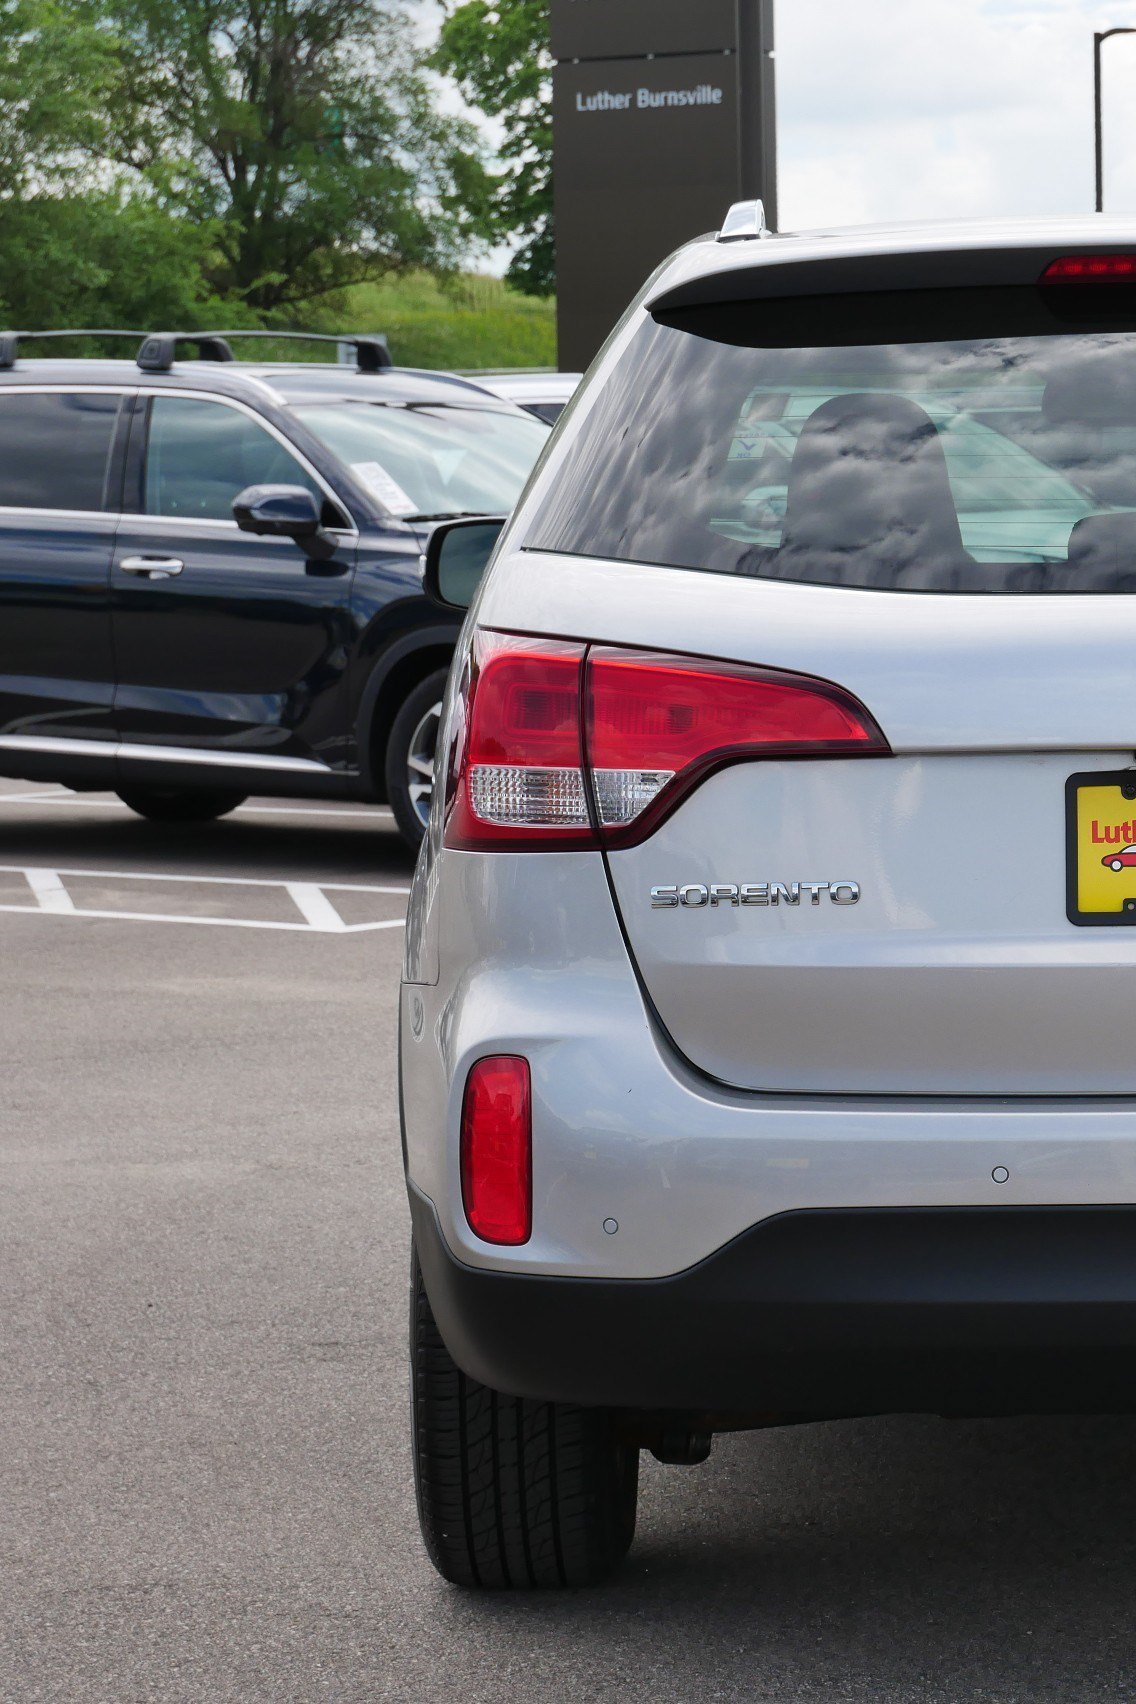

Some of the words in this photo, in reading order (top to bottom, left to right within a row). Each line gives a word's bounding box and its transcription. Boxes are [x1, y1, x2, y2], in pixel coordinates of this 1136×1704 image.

[576, 90, 633, 111] Luther
[636, 84, 723, 108] Burnsville
[650, 881, 860, 908] SORENTO
